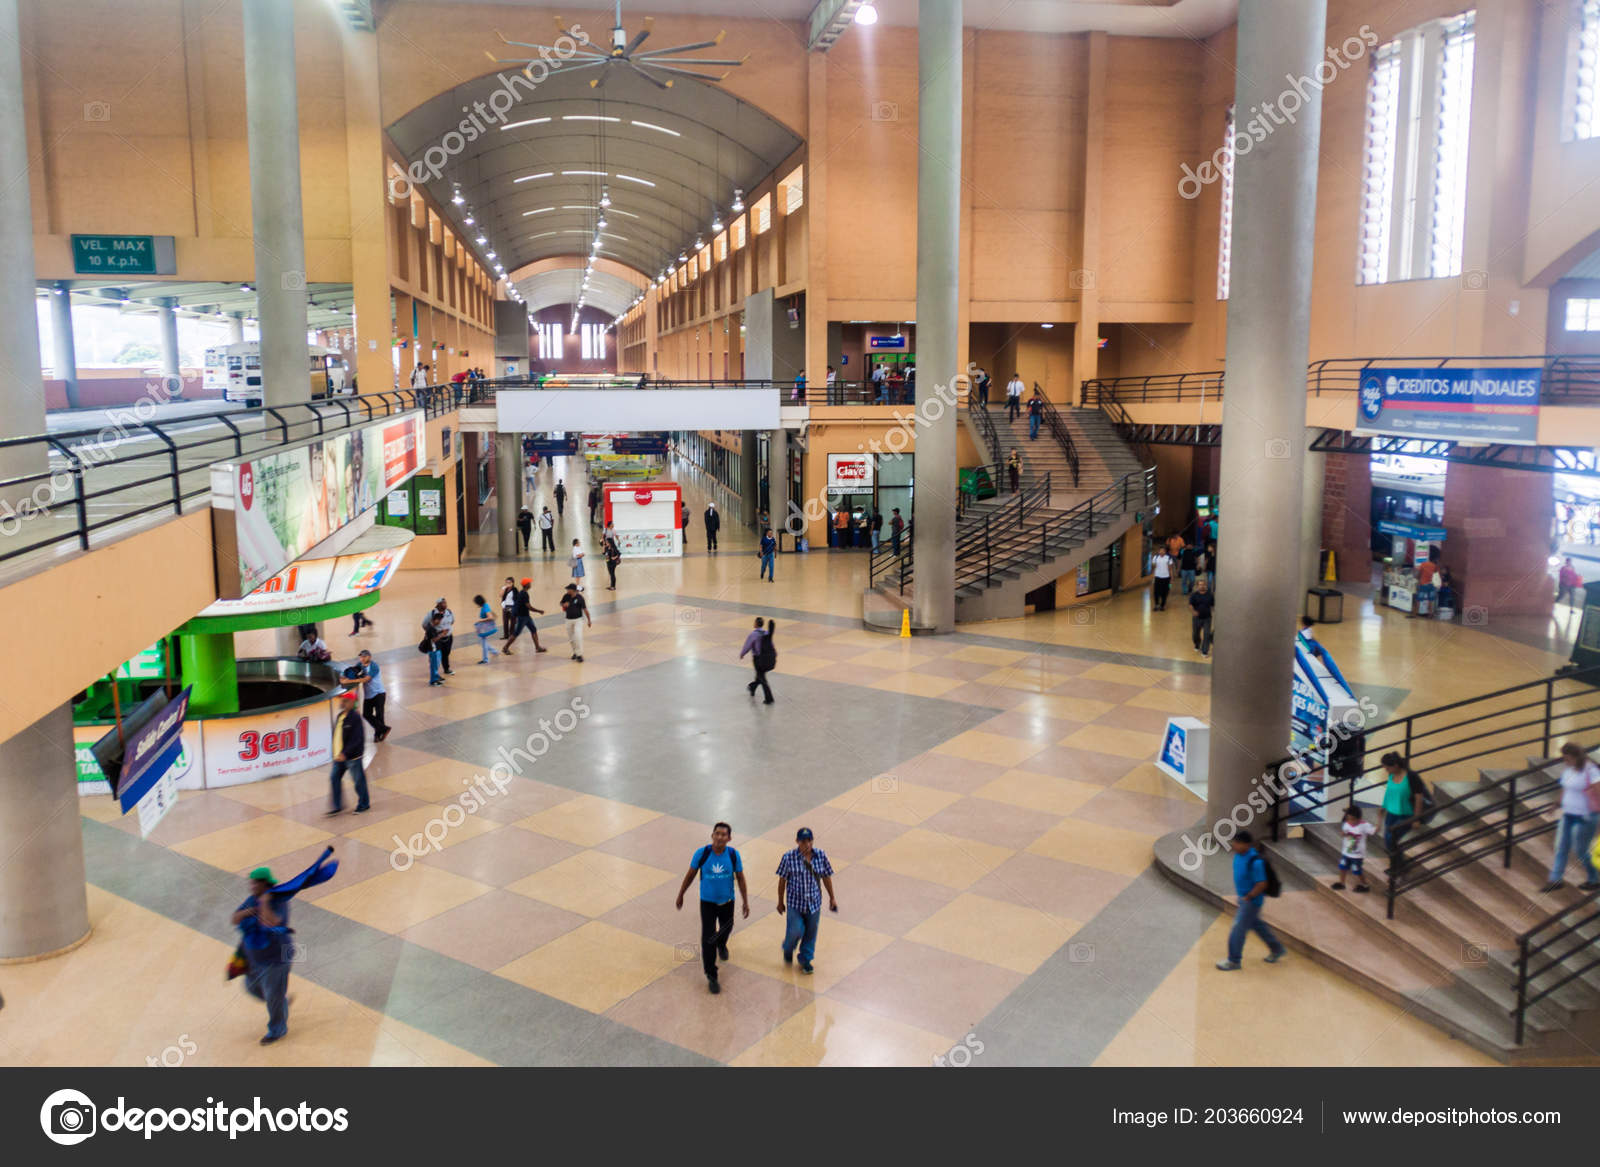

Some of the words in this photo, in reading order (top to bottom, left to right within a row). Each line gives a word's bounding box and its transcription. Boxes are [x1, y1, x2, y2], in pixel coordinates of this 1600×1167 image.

[80, 240, 107, 250] VEL.
[113, 240, 145, 251] MAX
[88, 255, 101, 265] 10
[107, 255, 141, 268] K.p.h.
[1396, 378, 1449, 395] CREDITOS
[1451, 378, 1536, 397] MUNDIALES
[837, 466, 865, 476] Clave
